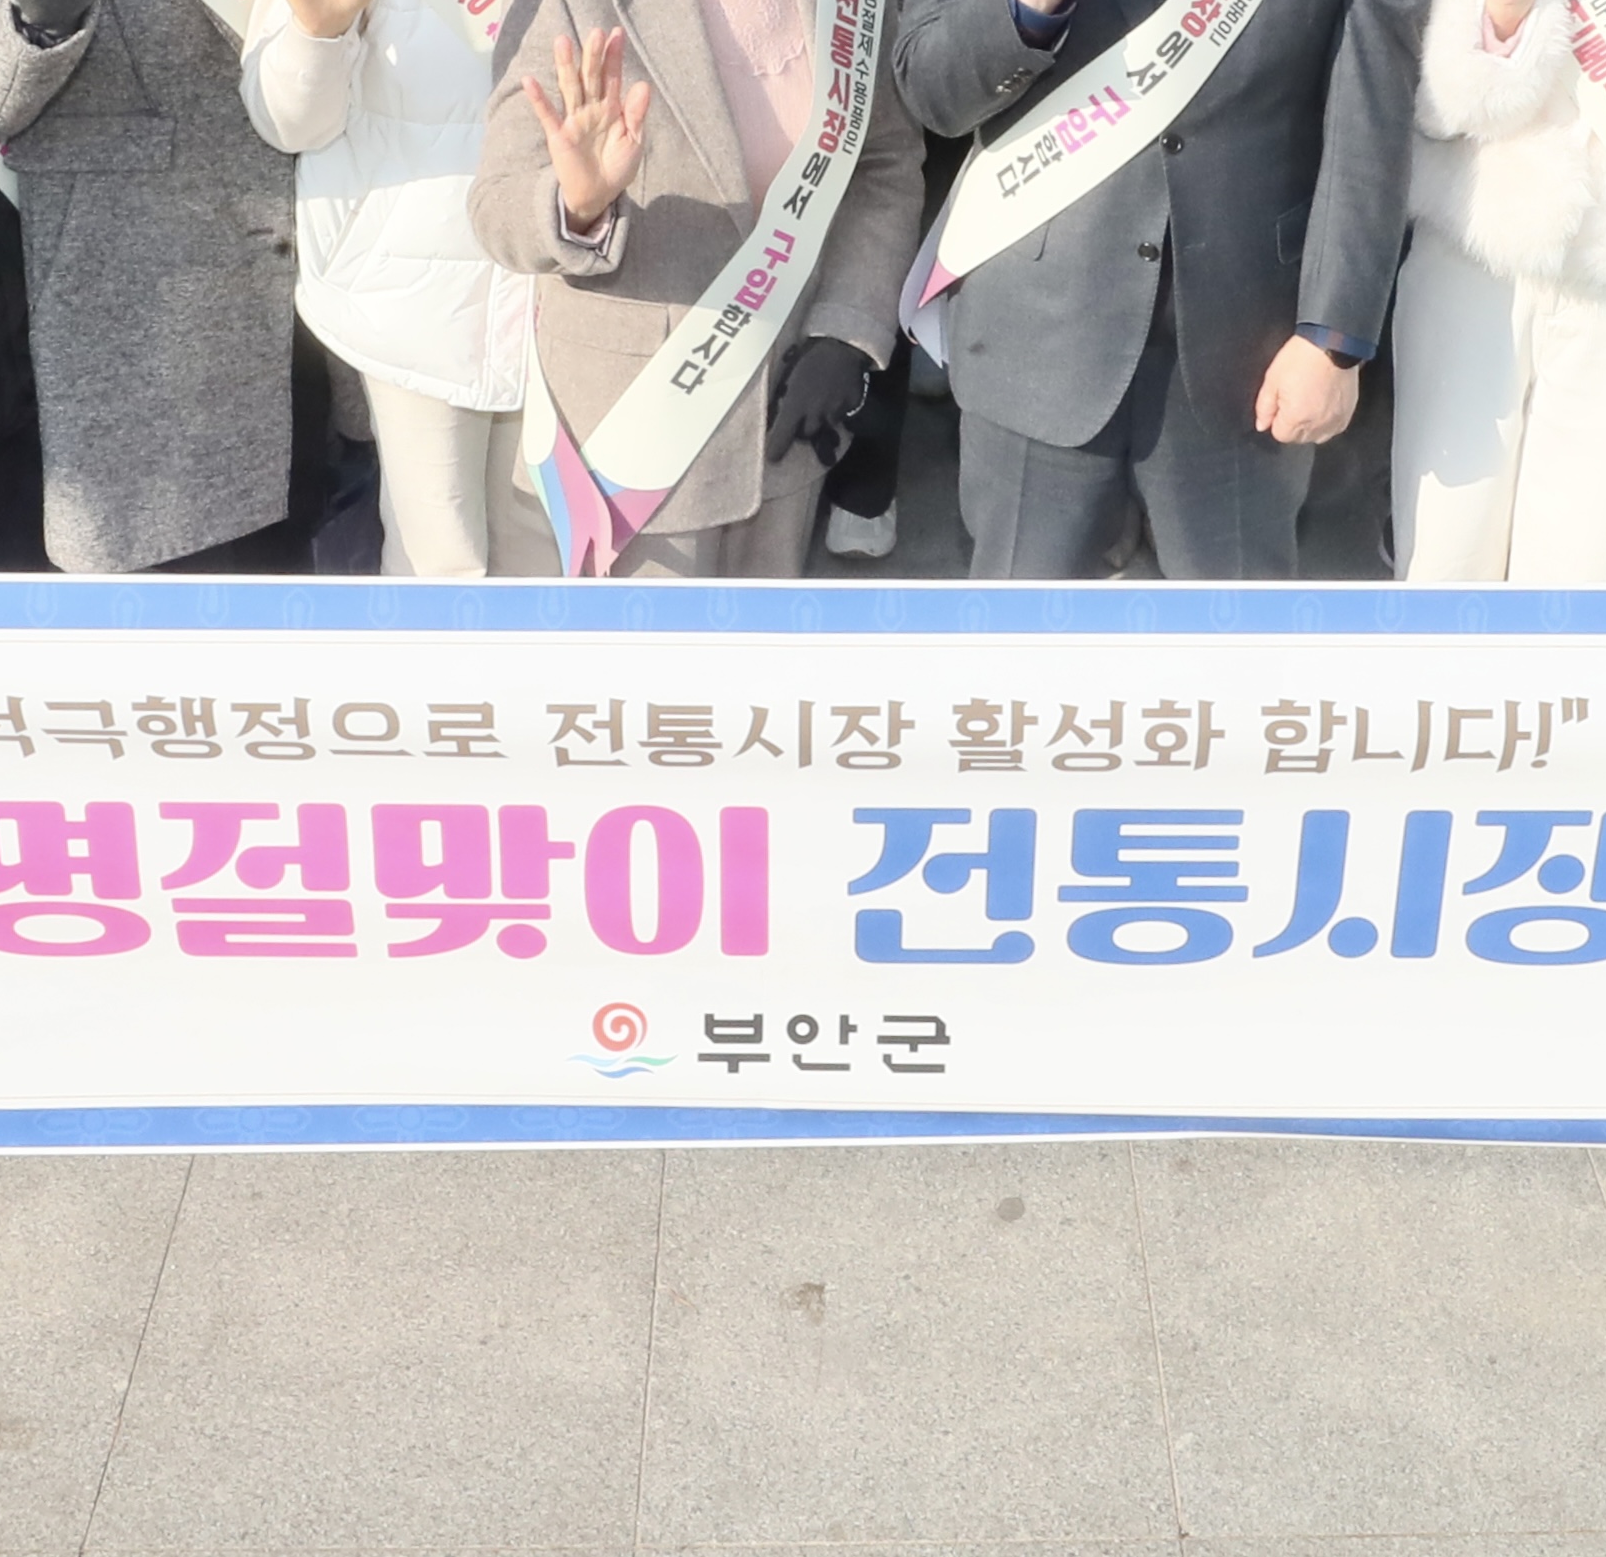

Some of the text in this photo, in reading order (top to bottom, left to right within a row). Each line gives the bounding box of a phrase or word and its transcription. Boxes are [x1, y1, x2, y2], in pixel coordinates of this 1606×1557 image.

[996, 85, 1132, 200] 구입합시다
[670, 228, 796, 396] 구입합시다
[546, 699, 916, 770] 전통시장
[948, 696, 1226, 773] 활성화
[1260, 694, 1591, 774] 합니다!"
[696, 1011, 953, 1074] 부안군
